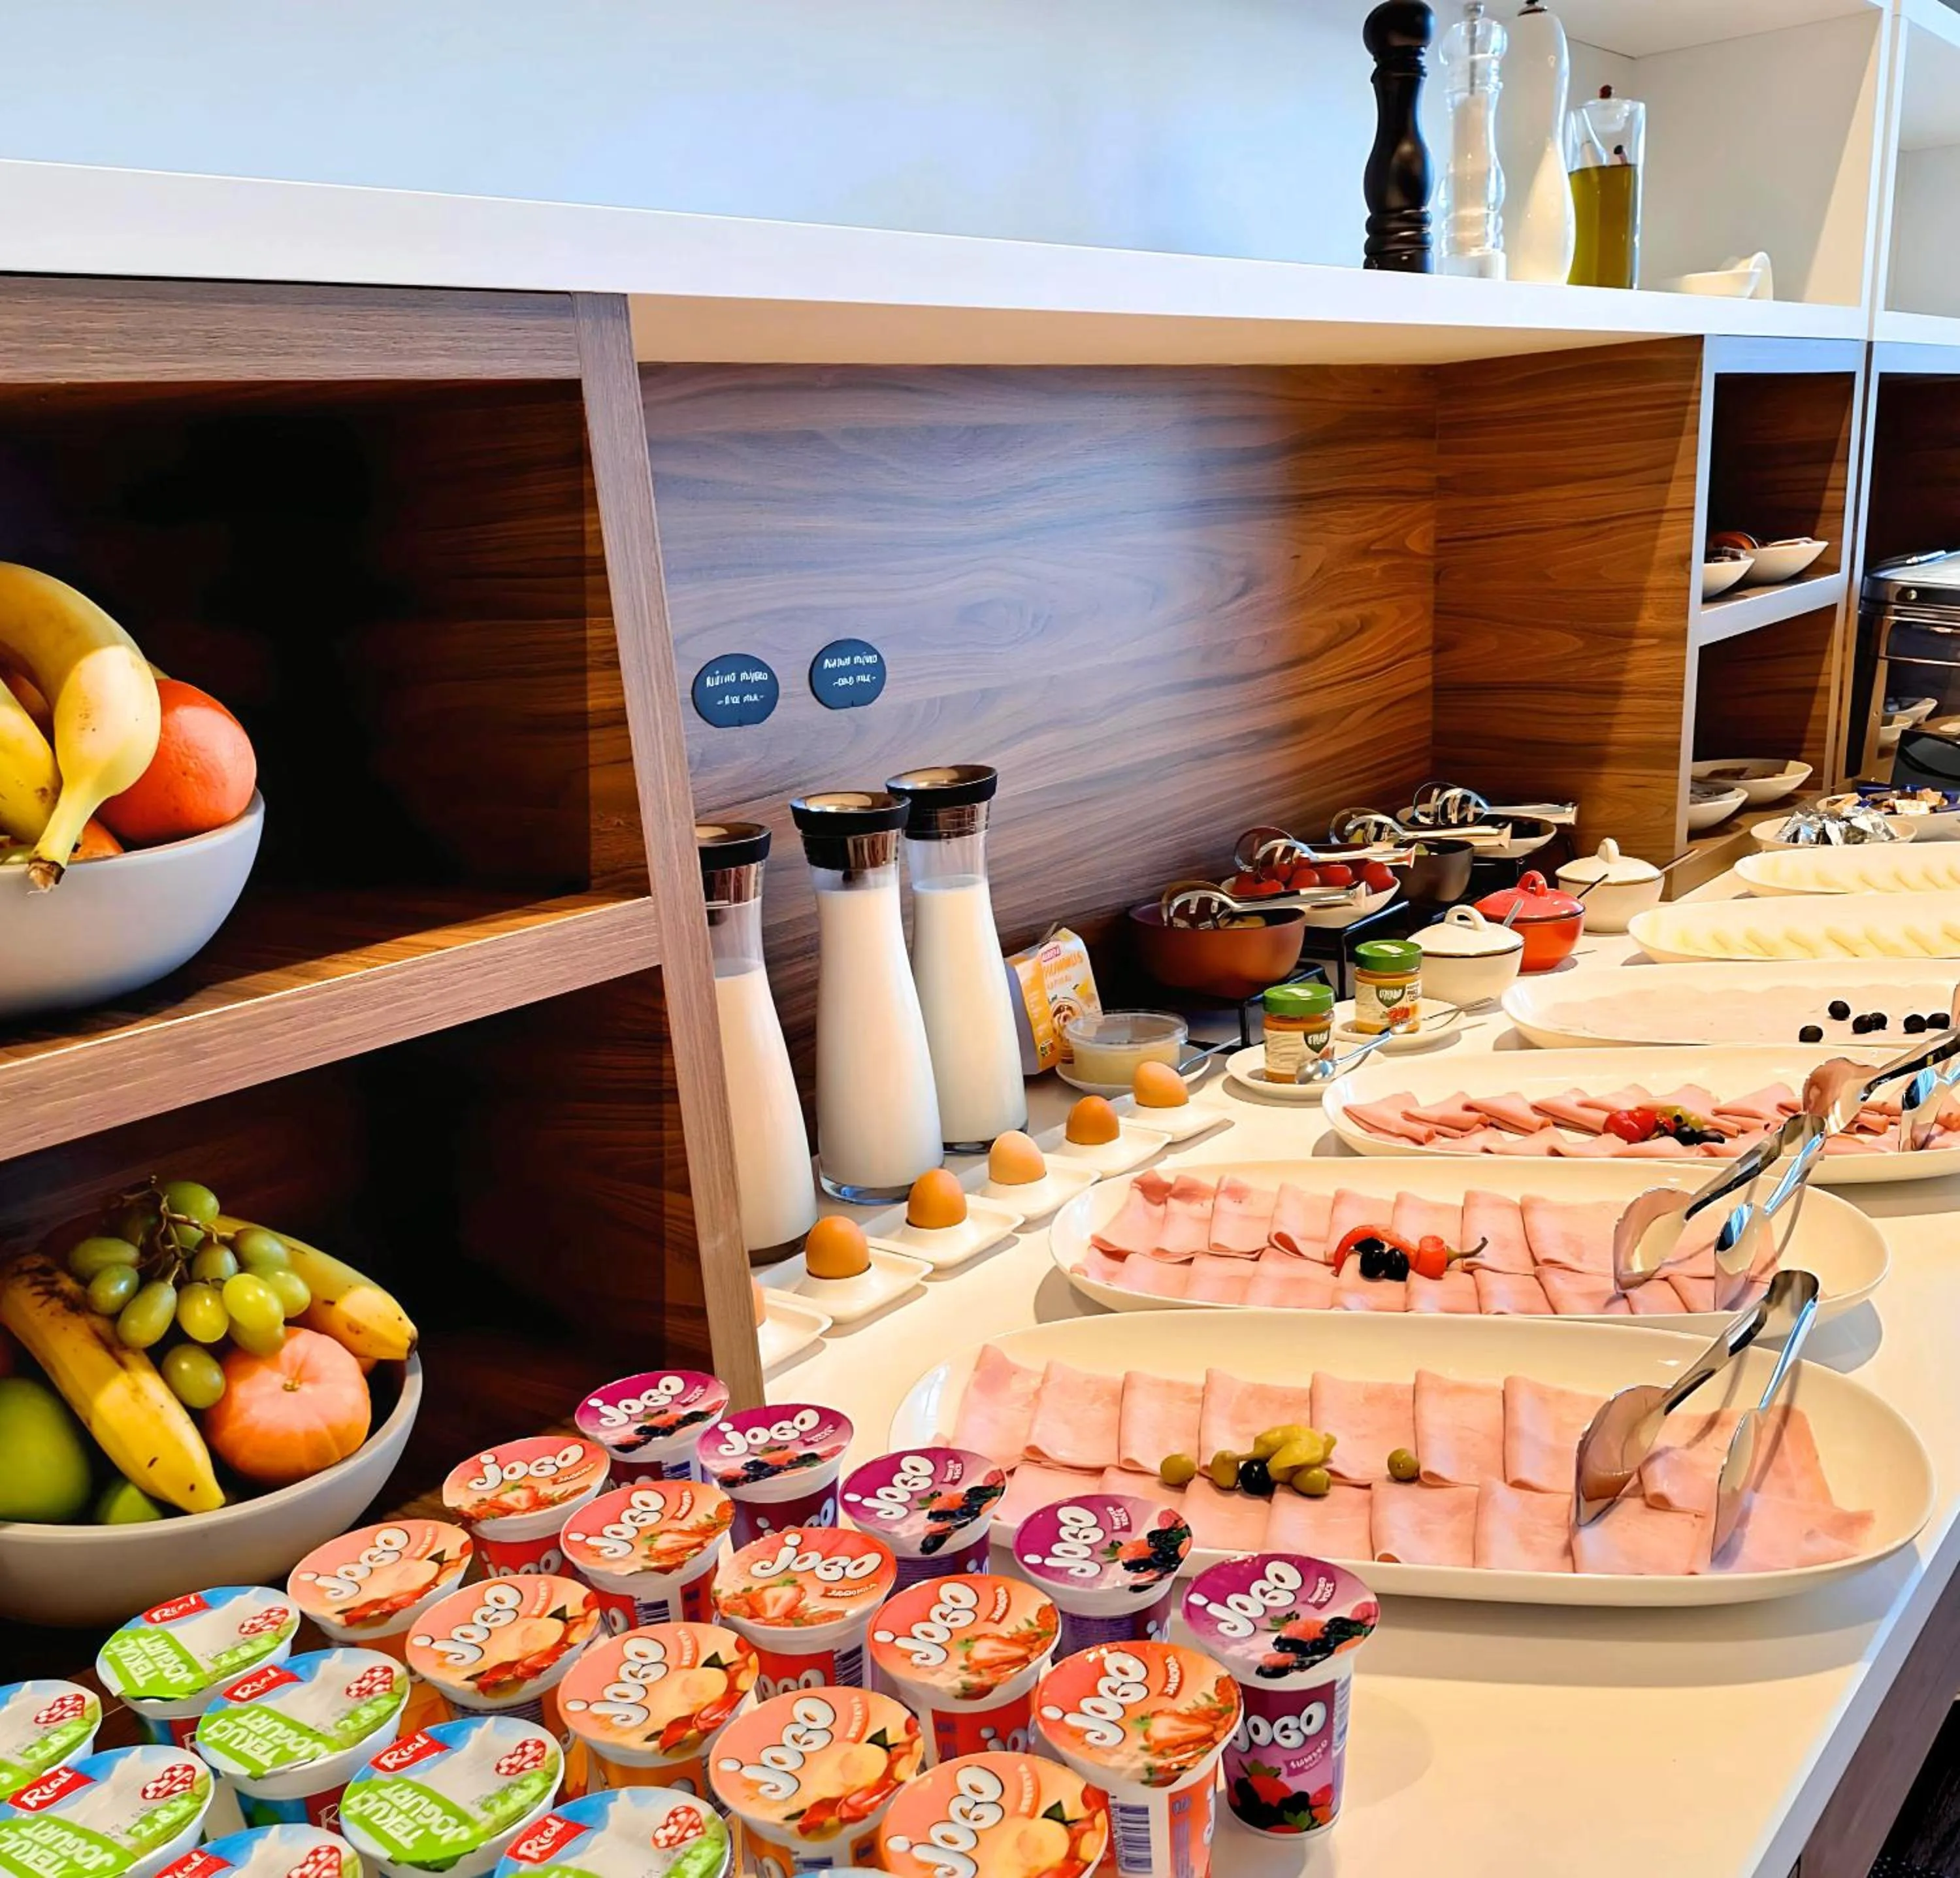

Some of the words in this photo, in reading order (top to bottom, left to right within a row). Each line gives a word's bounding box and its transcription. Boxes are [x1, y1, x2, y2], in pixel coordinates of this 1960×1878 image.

[137, 1633, 195, 1684] JOGURT
[379, 1732, 431, 1770] Rial
[20, 1768, 76, 1808] Rial
[377, 1782, 470, 1845] JOGURT
[18, 1820, 117, 1870] JOGURT
[517, 1817, 567, 1860] Rial
